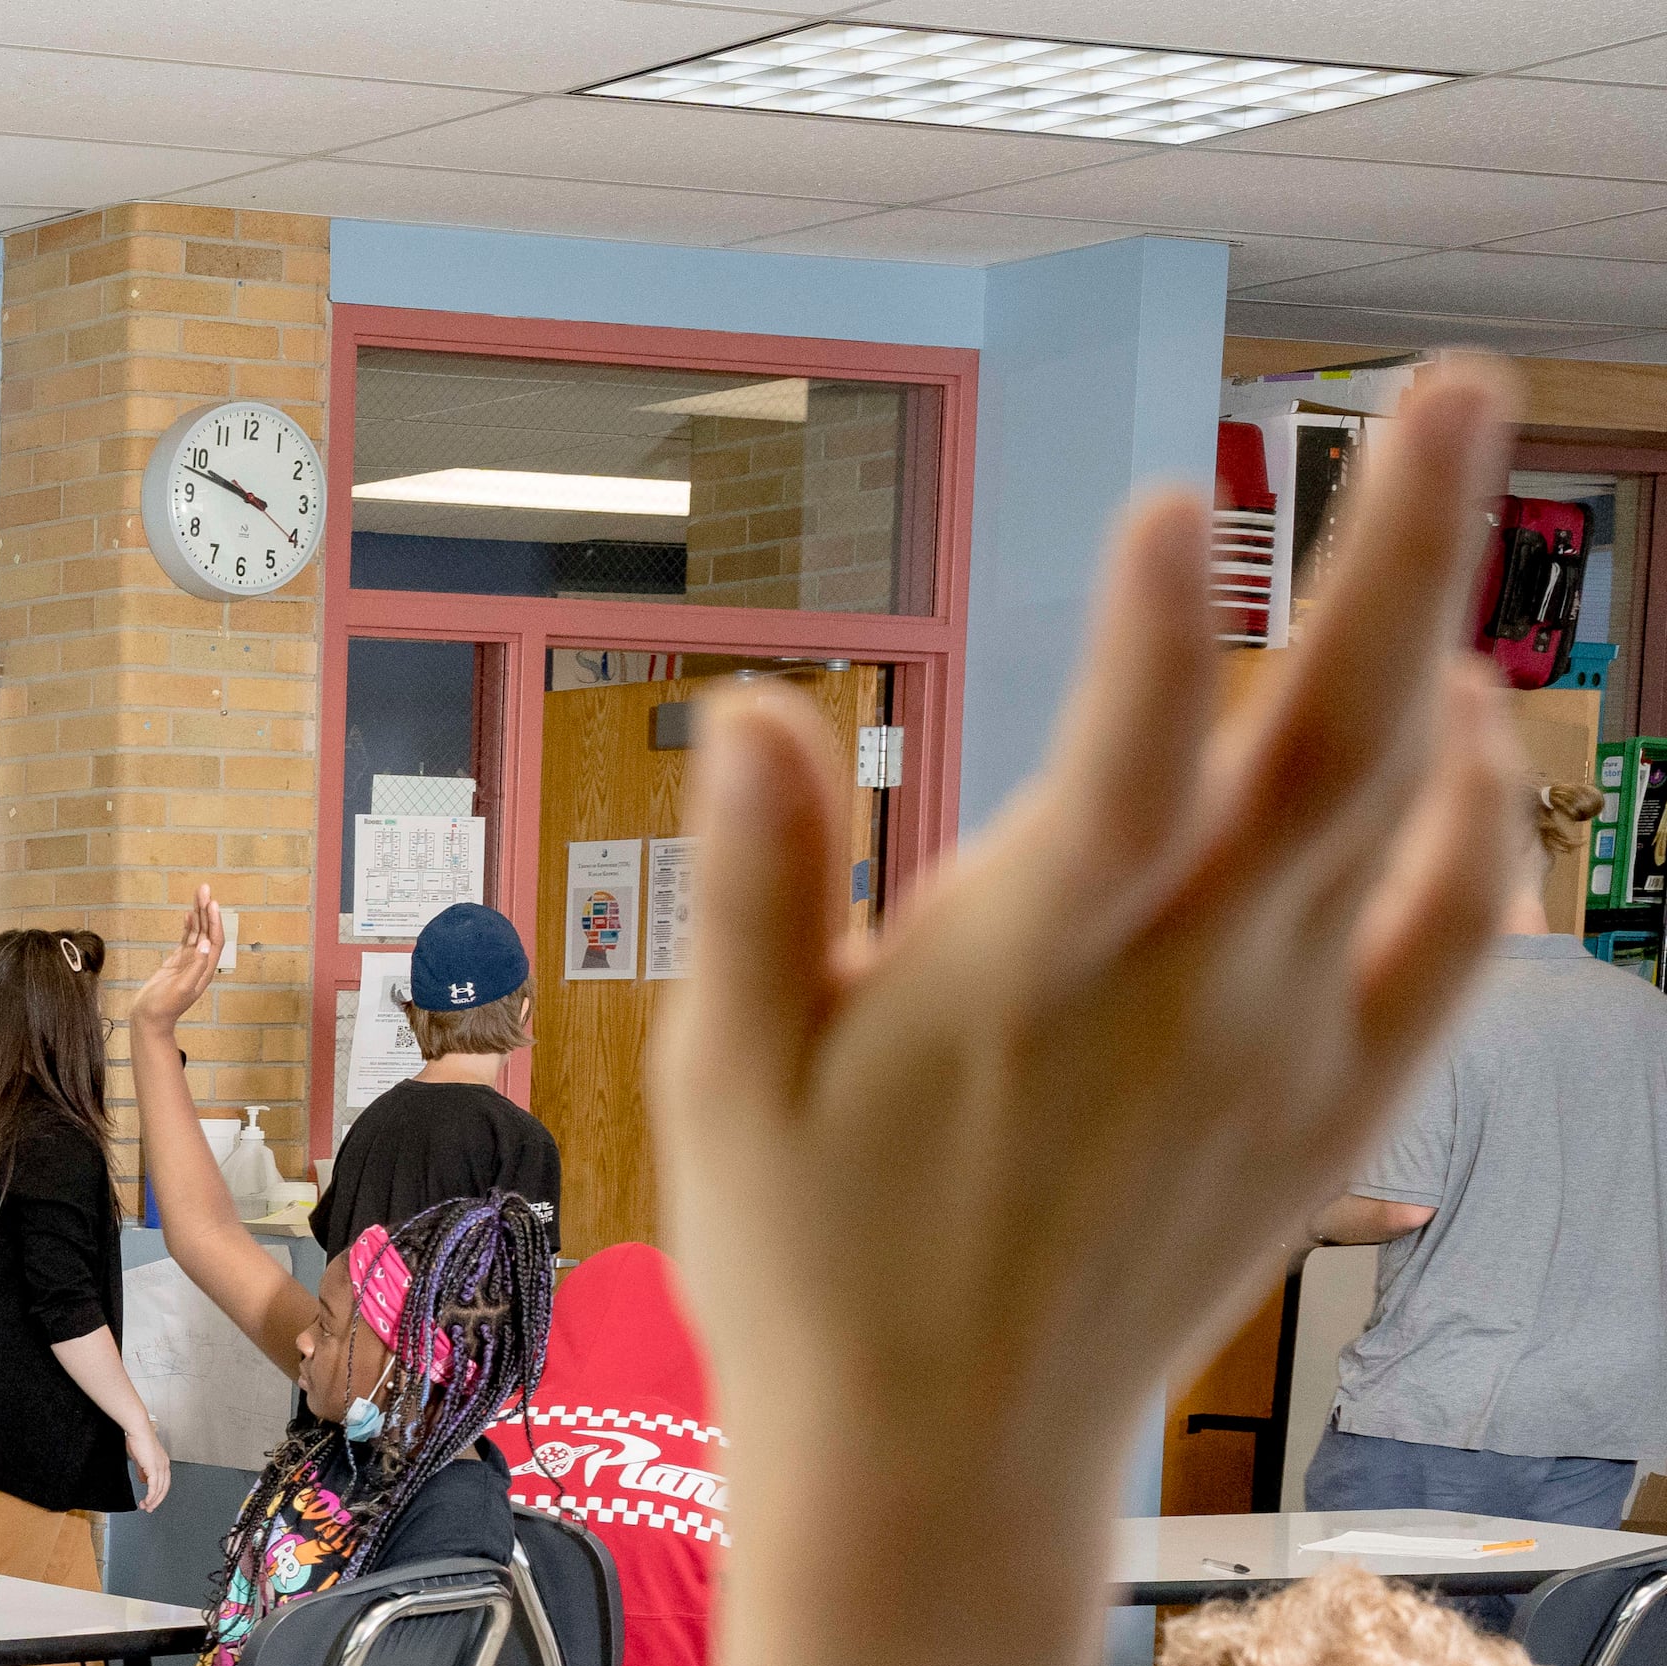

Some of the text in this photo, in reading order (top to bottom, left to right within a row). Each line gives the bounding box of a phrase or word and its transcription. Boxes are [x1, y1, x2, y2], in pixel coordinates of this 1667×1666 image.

[216, 425, 230, 447] 11
[243, 419, 260, 441] 12
[276, 433, 282, 454] 1
[192, 447, 209, 470] 10
[292, 460, 304, 481] 2
[184, 482, 195, 503] 9
[298, 495, 309, 515] 3
[190, 517, 201, 537] 8
[288, 528, 298, 549] 4
[210, 543, 220, 564] 7
[265, 549, 276, 569] 5
[236, 556, 246, 577] 6
